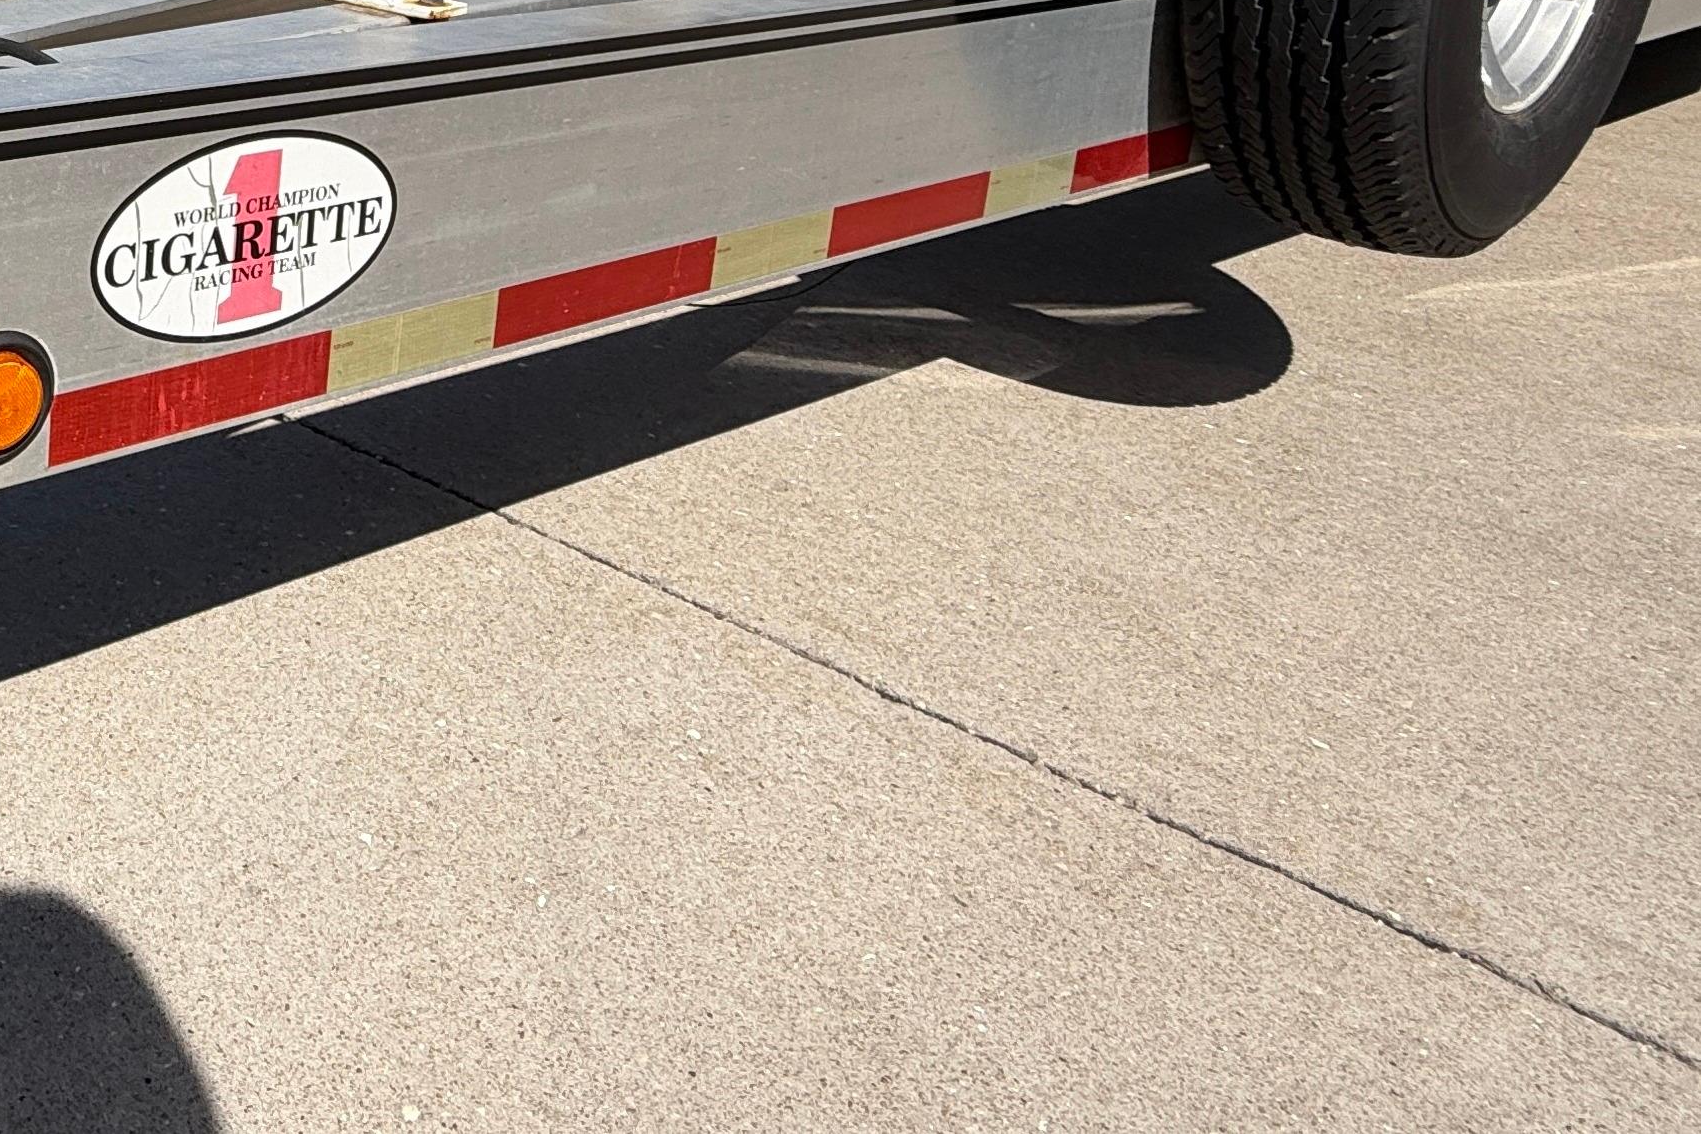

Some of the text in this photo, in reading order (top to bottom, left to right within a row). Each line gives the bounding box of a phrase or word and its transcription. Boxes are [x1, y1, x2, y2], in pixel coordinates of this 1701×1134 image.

[174, 183, 340, 227] WORLD CHAMPION
[104, 196, 383, 288] CIGARETTE
[194, 251, 317, 292] RACING TEAM
